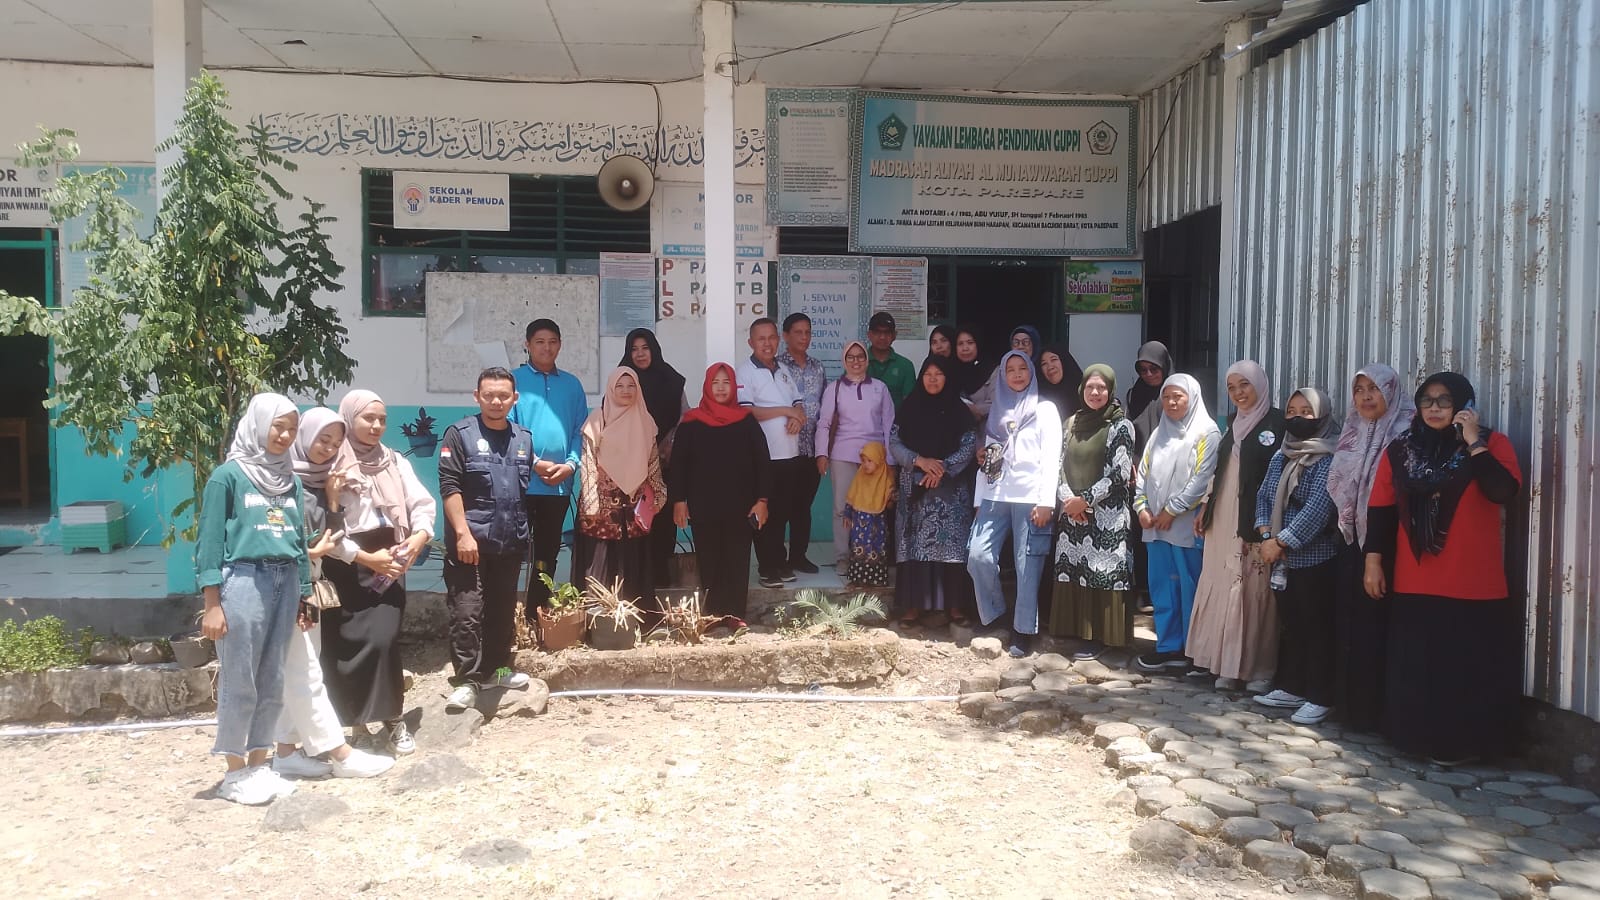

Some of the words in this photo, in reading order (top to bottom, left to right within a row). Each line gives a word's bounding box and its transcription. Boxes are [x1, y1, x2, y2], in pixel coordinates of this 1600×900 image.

[913, 124, 953, 148] YAYASAN
[954, 126, 995, 150] LEMBAGA
[998, 128, 1051, 151] PENDIDIKAN
[1054, 130, 1081, 152] GUPPI
[870, 160, 932, 179] MADRASAH
[934, 161, 975, 180] ALIYAH
[978, 163, 993, 181] AL
[995, 164, 1082, 182] MUNAWWARAH
[1084, 166, 1118, 183] GUPPI
[429, 186, 473, 196] SEKOLAH
[918, 186, 972, 197] KOTA
[978, 187, 1084, 199] PAREPARE
[429, 196, 461, 204] KADER
[466, 197, 505, 205] PEMUDA
[751, 262, 763, 274] A
[751, 282, 763, 294] B
[1068, 281, 1109, 293] Sekolahku
[811, 293, 846, 302] SENYUM
[751, 303, 764, 315] C
[811, 306, 835, 314] SAPA
[811, 318, 841, 326] SALAM
[811, 330, 840, 338] SOPAN
